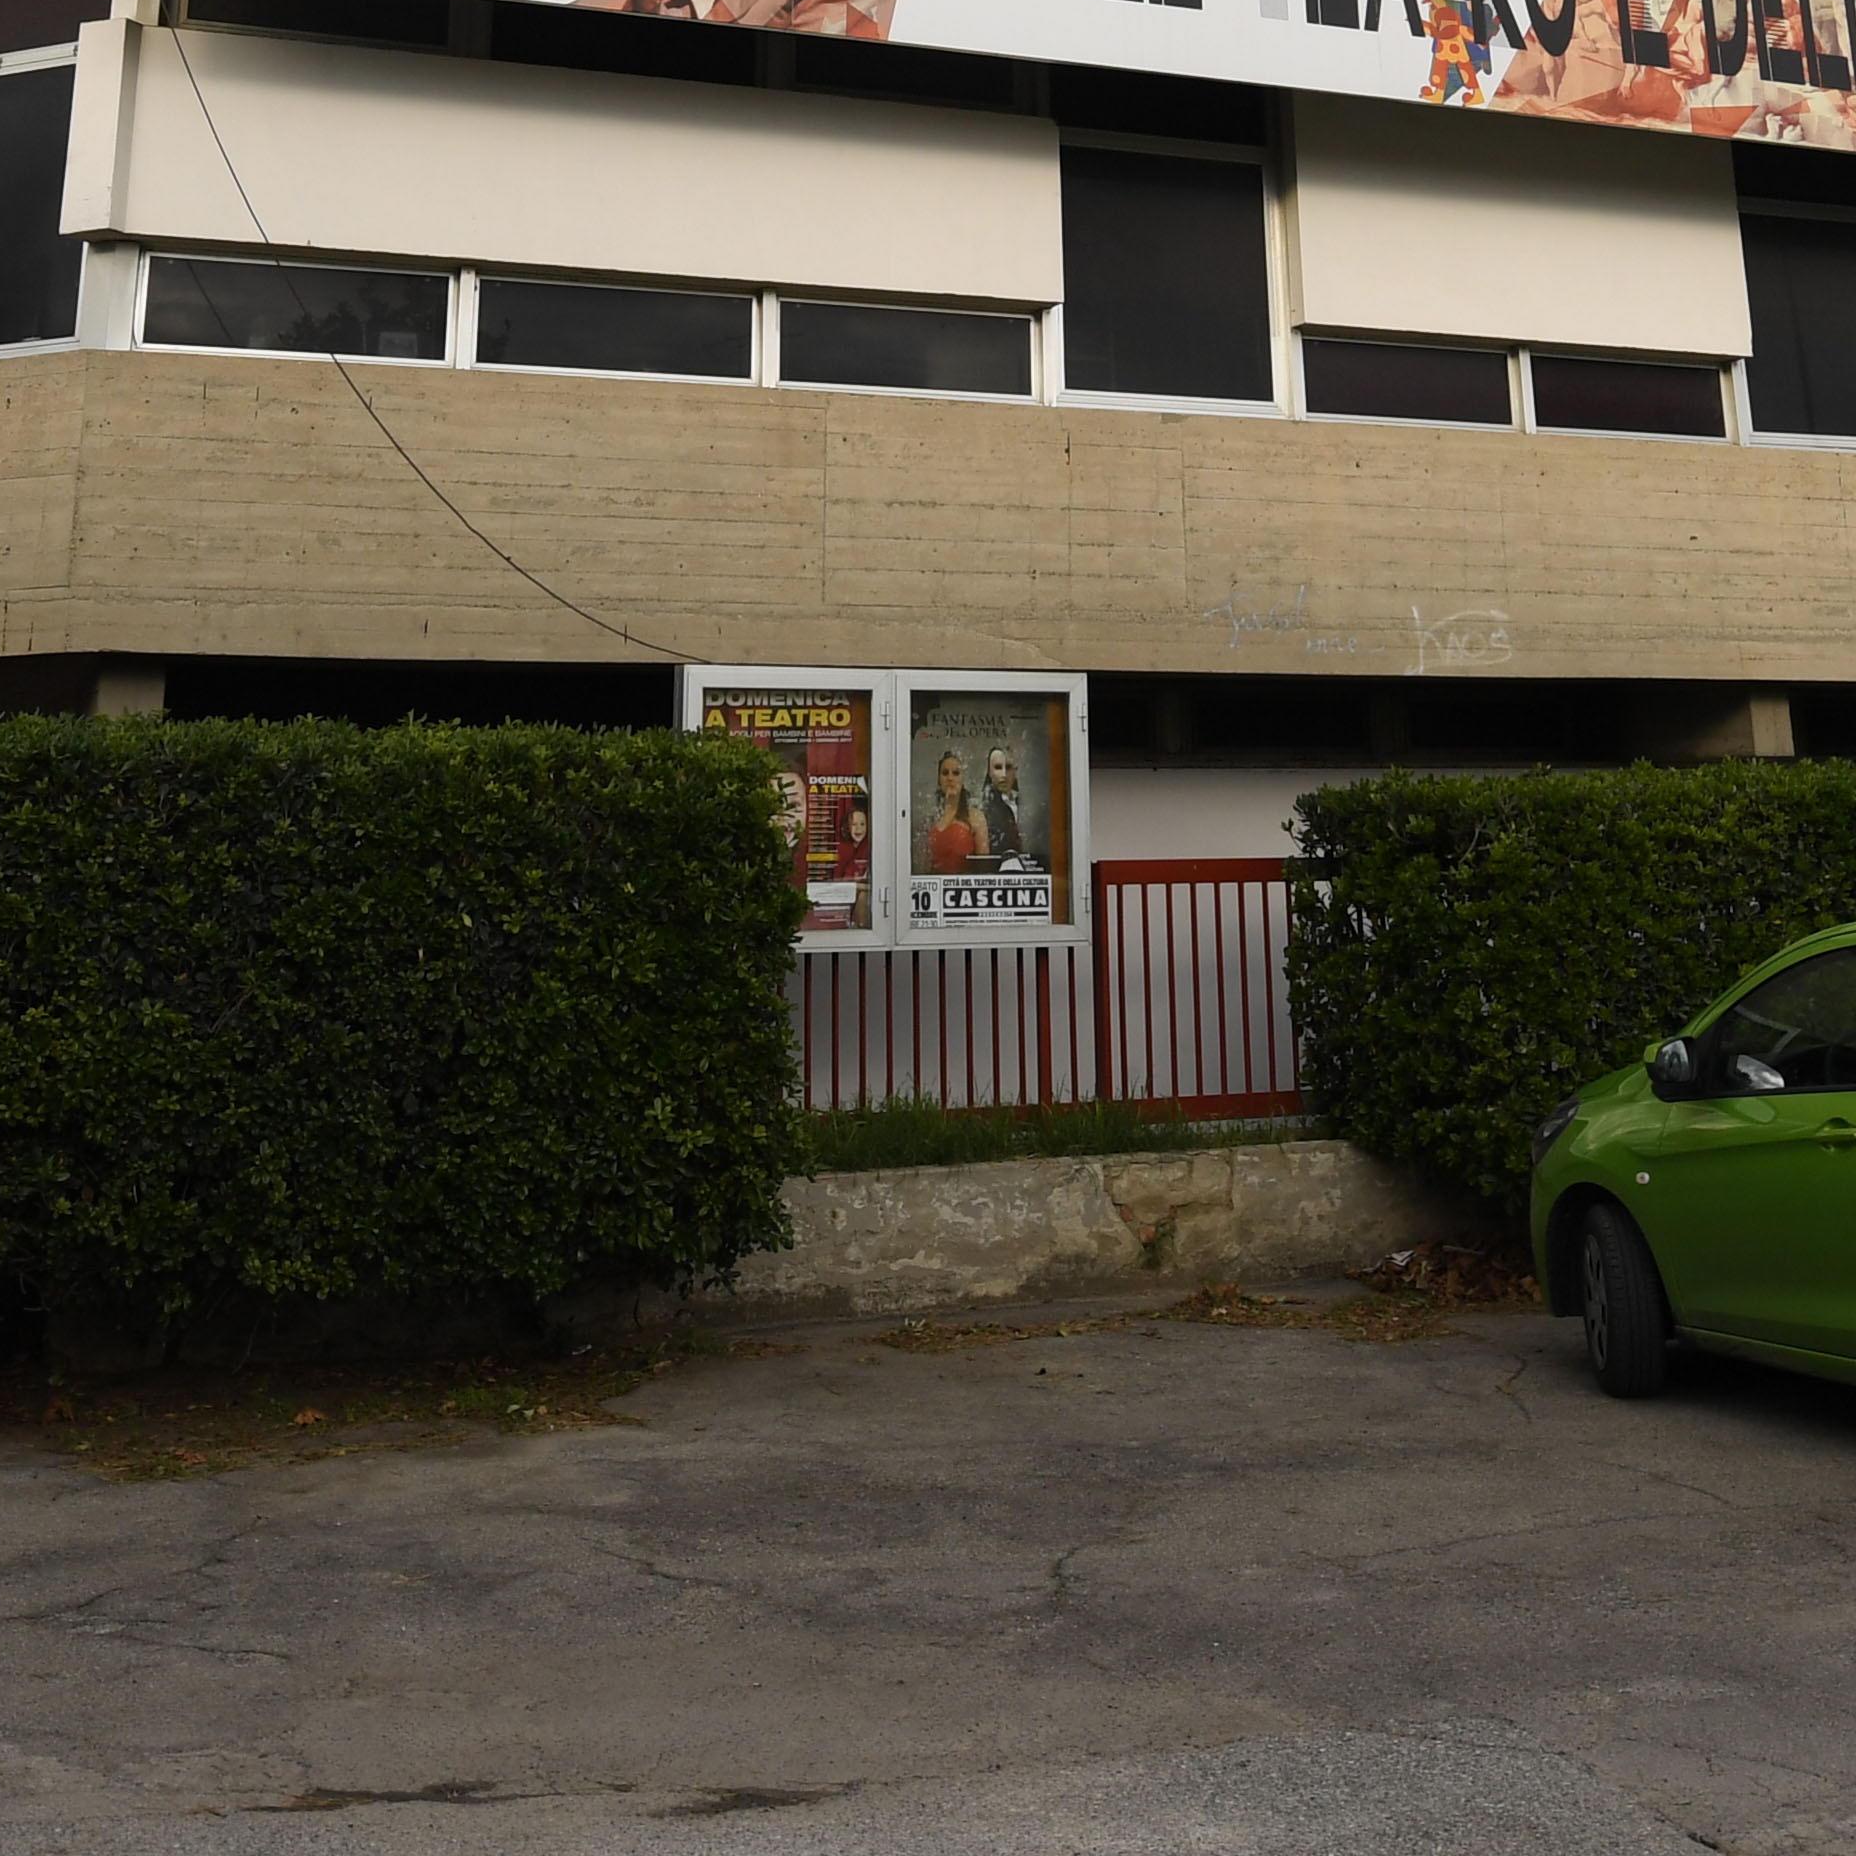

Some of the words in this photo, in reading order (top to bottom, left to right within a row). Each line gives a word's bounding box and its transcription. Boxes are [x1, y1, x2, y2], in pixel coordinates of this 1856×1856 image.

[705, 690, 850, 707] DOMENICA
[704, 709, 727, 728] A
[735, 708, 852, 728] TEATRO
[912, 892, 931, 911] 10
[944, 889, 1048, 907] CASCINA
